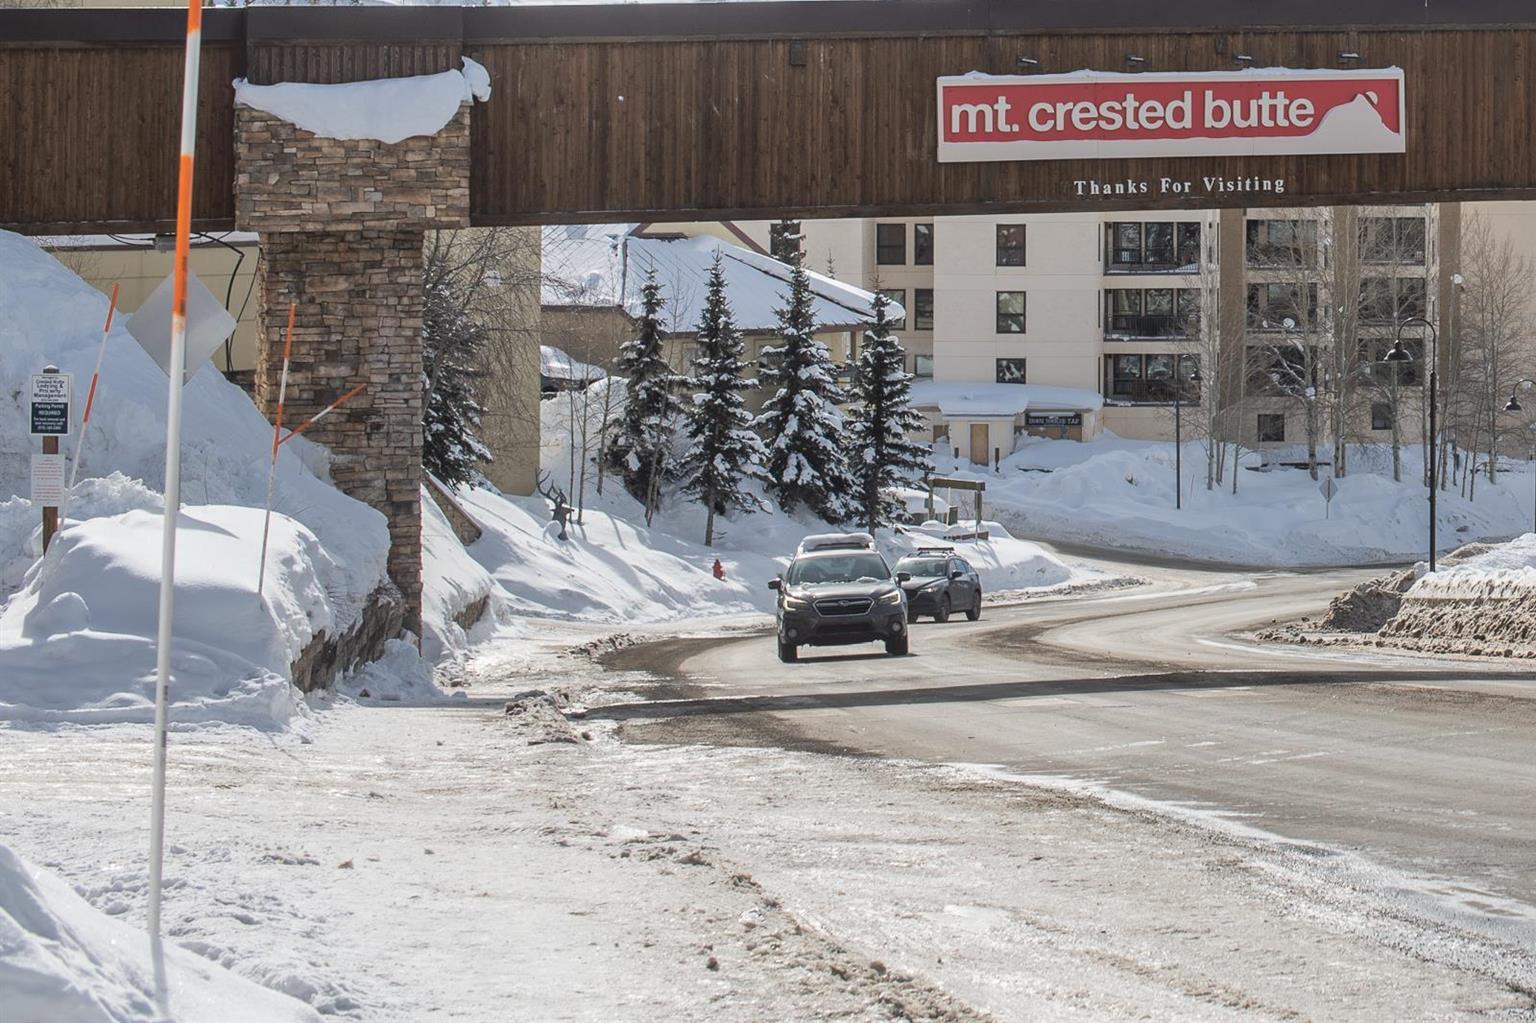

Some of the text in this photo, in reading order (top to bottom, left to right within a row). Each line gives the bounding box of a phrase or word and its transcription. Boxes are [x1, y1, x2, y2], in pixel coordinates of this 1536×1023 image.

[951, 89, 1315, 133] mt. crested butte
[1074, 176, 1285, 195] Thanks For Visiting
